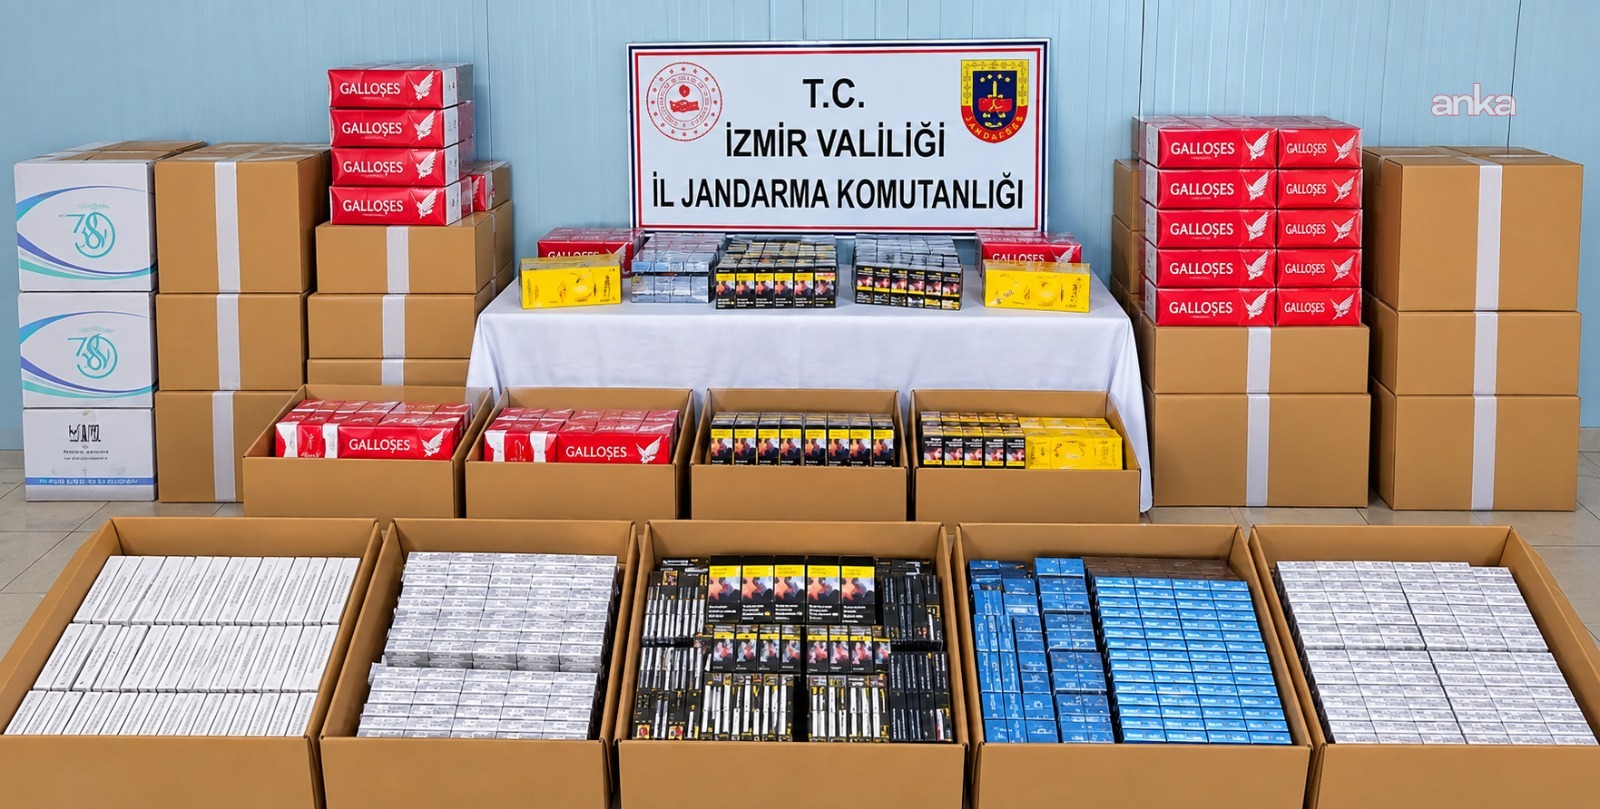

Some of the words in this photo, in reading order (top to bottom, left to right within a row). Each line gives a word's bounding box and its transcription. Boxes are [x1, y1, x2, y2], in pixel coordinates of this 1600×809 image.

[803, 78, 864, 109] T.C.
[726, 121, 808, 157] İZMİR
[817, 121, 946, 158] VALİLİĞİ
[653, 171, 675, 207] İL
[681, 178, 830, 208] JANDARMA
[838, 172, 1024, 210] KOMUTANLIĞI
